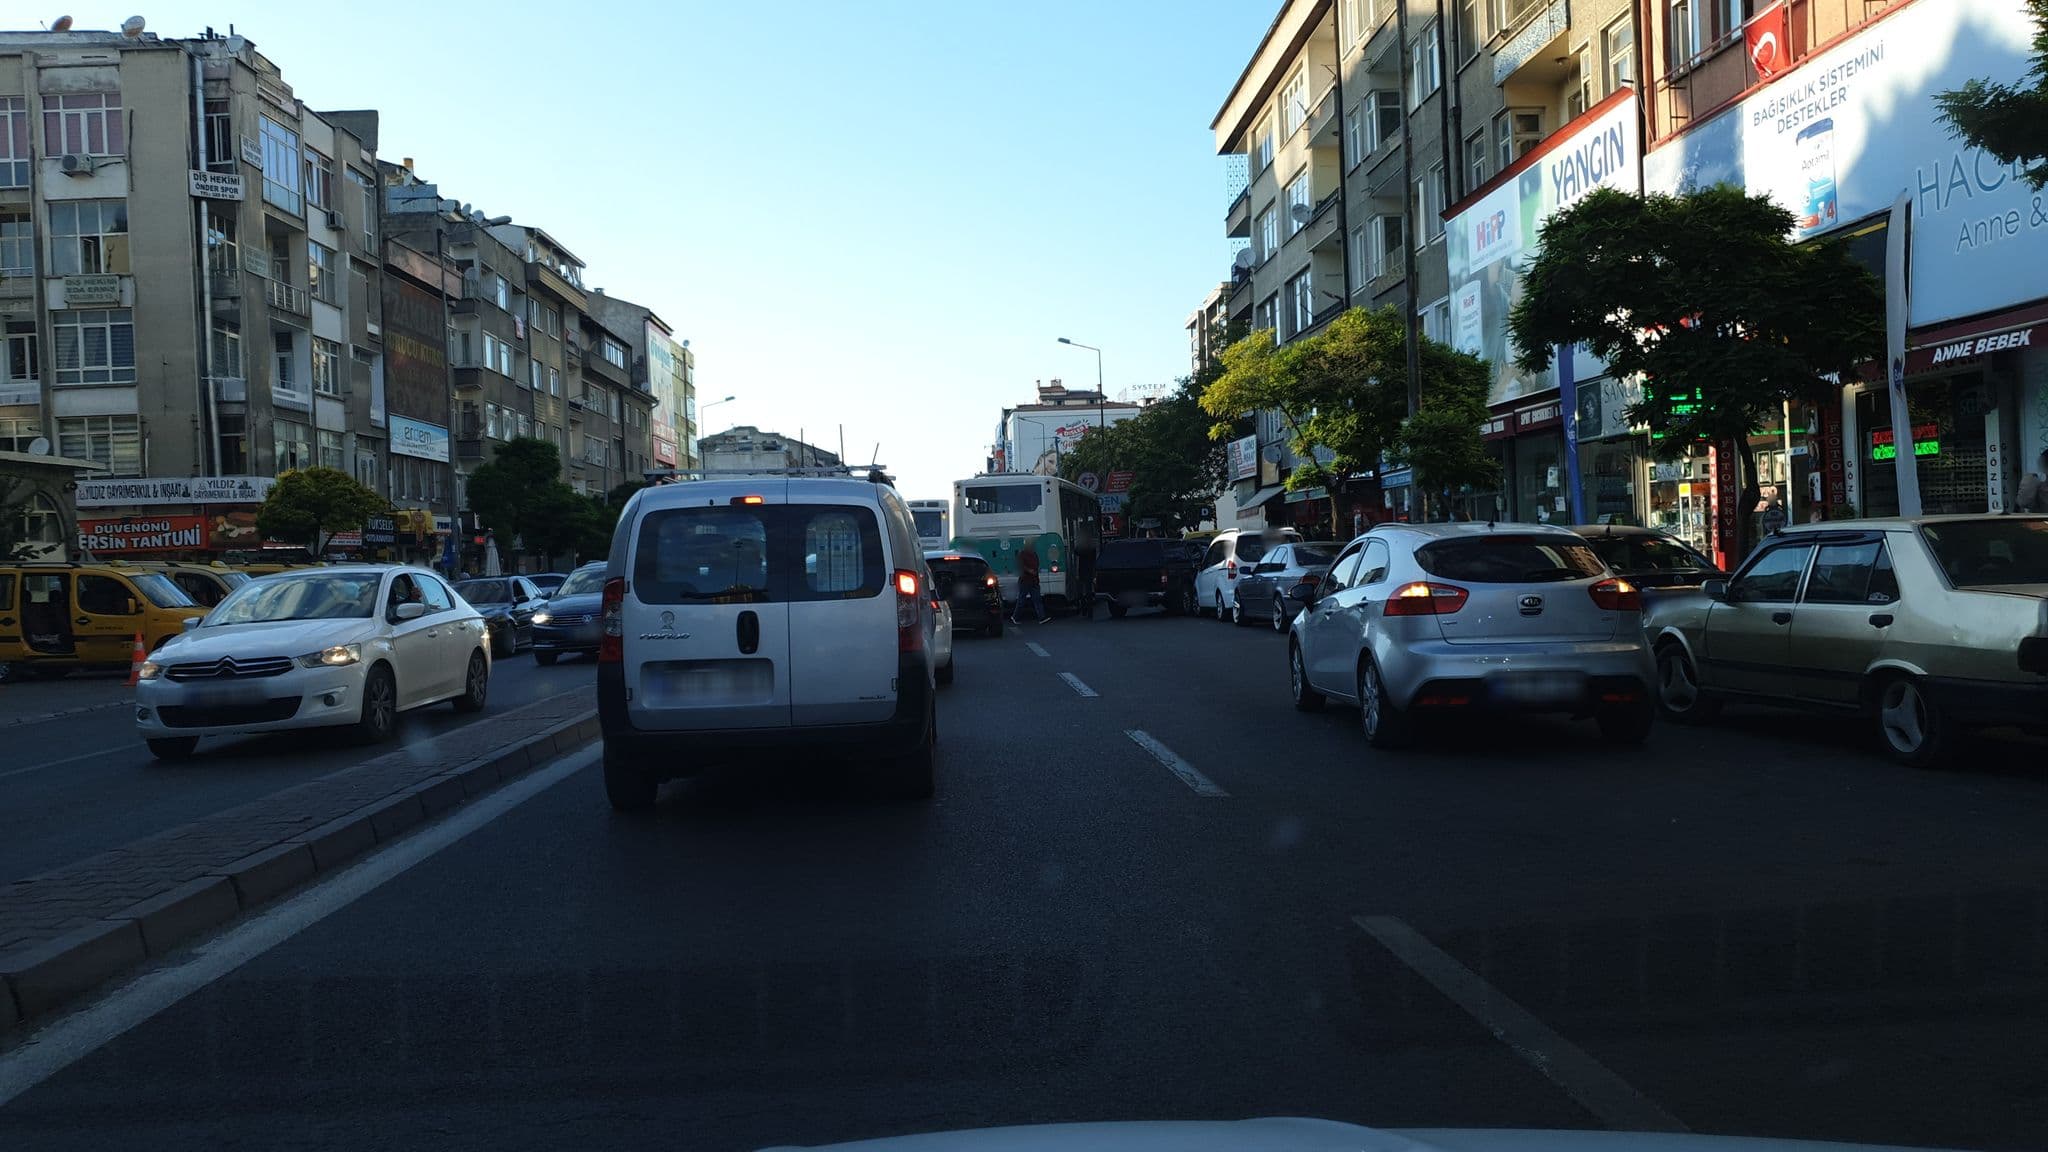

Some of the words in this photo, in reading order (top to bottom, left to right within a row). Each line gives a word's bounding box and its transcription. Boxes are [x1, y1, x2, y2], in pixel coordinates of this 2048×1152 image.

[1753, 80, 1816, 127] BAĞIŞIKLIK
[1818, 39, 1885, 92] SİSTEMİNİ
[1551, 120, 1625, 205] YANGIN
[193, 172, 208, 183] DİŞ
[209, 173, 241, 185] HEKİMİ
[194, 182, 219, 192] ÖNDER
[220, 187, 239, 195] SPOR
[1826, 201, 1835, 219] 4
[1476, 209, 1506, 250] HiPP
[1956, 210, 2021, 253] Anne
[1932, 341, 1975, 364] ANNE
[1974, 329, 2033, 355] BEBEK
[1131, 383, 1166, 391] SYSTEM
[85, 485, 105, 500] YILDIZ
[207, 479, 236, 489] YILDIZ
[77, 532, 127, 550] ERSİN
[131, 523, 201, 548] TANTUNİ
[94, 521, 171, 535] DÜVENÖNÜ
